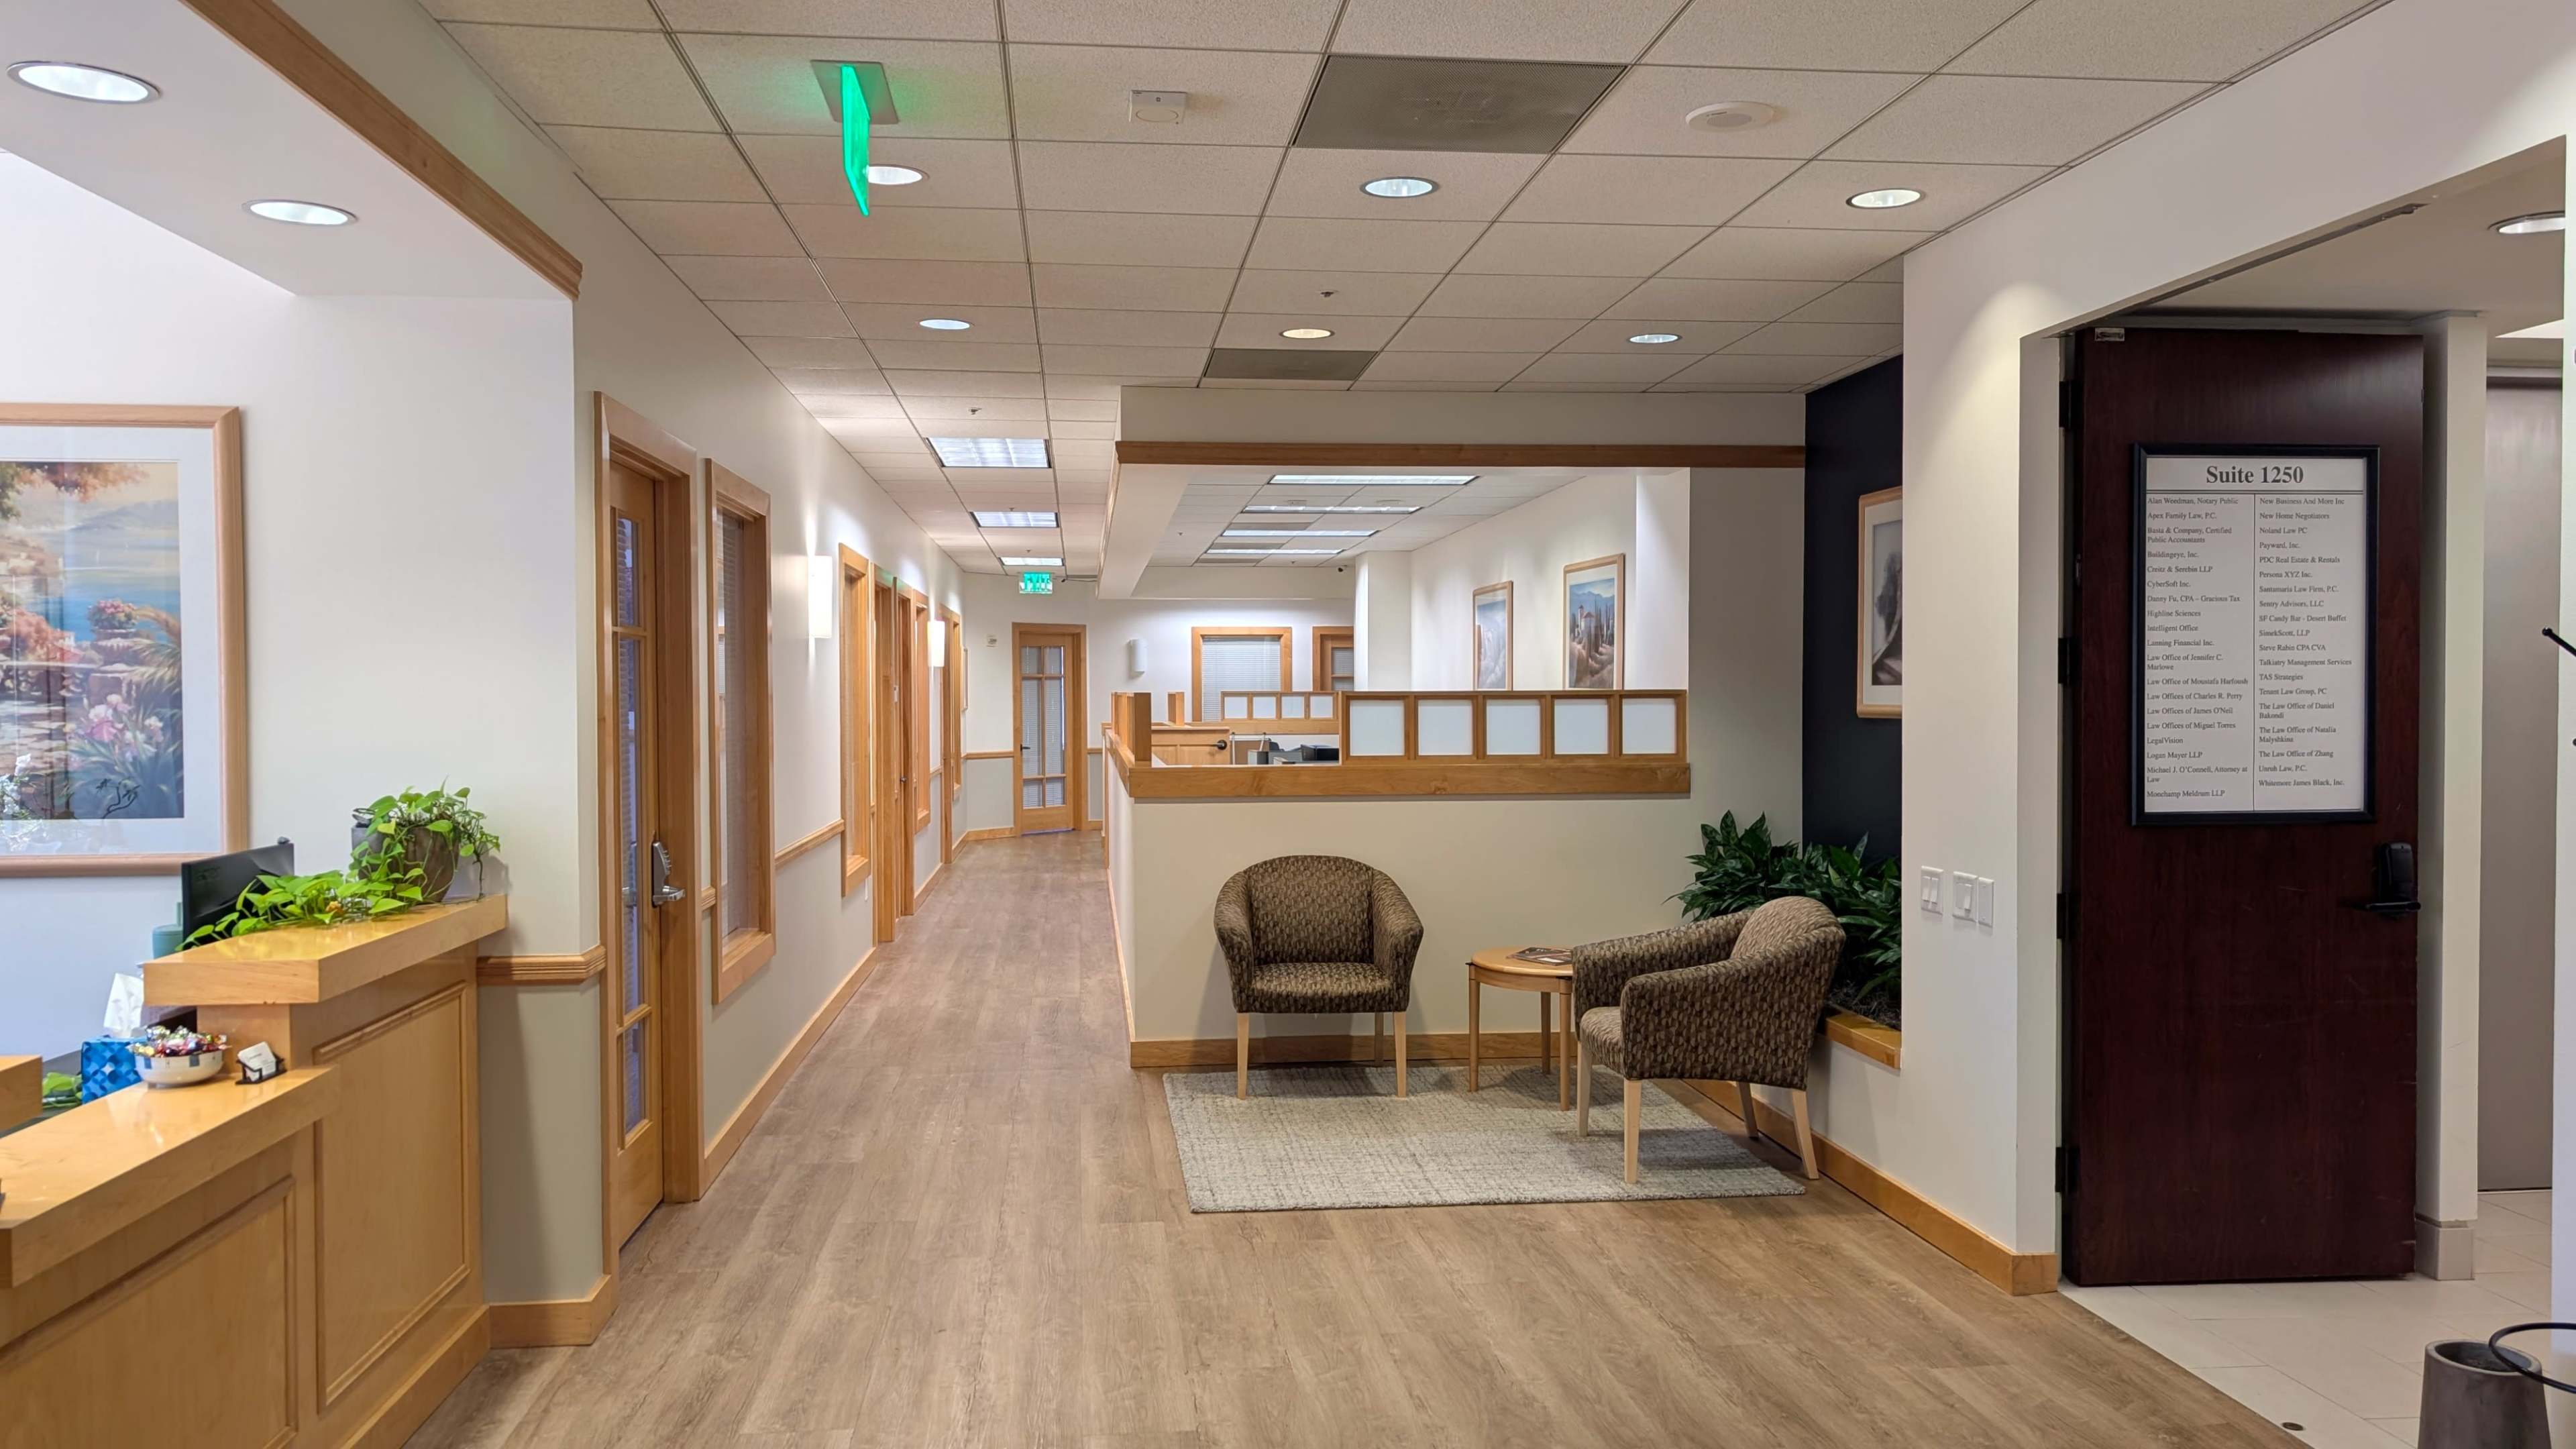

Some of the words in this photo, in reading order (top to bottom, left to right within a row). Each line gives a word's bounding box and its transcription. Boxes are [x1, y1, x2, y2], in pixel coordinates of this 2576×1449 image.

[2206, 465, 2255, 484] Suite
[2261, 466, 2304, 484] 1250
[2196, 497, 2218, 506] Notary
[2147, 513, 2163, 521] Apex
[2165, 512, 2187, 521] Family
[2188, 512, 2204, 520] Law,
[2295, 513, 2330, 521] Negotiators
[2173, 527, 2204, 535] Company,
[1024, 574, 1051, 592] EXIT
[2147, 580, 2178, 589] CyberSoft
[2147, 595, 2167, 603] Danny
[2259, 600, 2279, 608] Sentry
[2147, 610, 2174, 619] Highline
[2269, 614, 2288, 623] Candy
[2147, 625, 2178, 633] Intelligent
[2178, 624, 2198, 632] Office
[2147, 639, 2172, 648] Lanning
[2259, 659, 2286, 667] Talkiatry
[2287, 659, 2326, 667] Management
[2259, 673, 2273, 681] TAS
[2273, 674, 2304, 682] Strategies
[2226, 692, 2243, 701] Perry
[2295, 688, 2316, 696] Group,
[2193, 722, 2216, 731] Miguel
[2147, 737, 2184, 746] LegalVision
[2147, 752, 2166, 760] Logan
[2167, 751, 2188, 760] Mayer
[2188, 751, 2203, 759] LLP
[2314, 750, 2334, 758] Zhang
[2214, 766, 2241, 774] Attorney
[2333, 778, 2346, 786] Inc.
